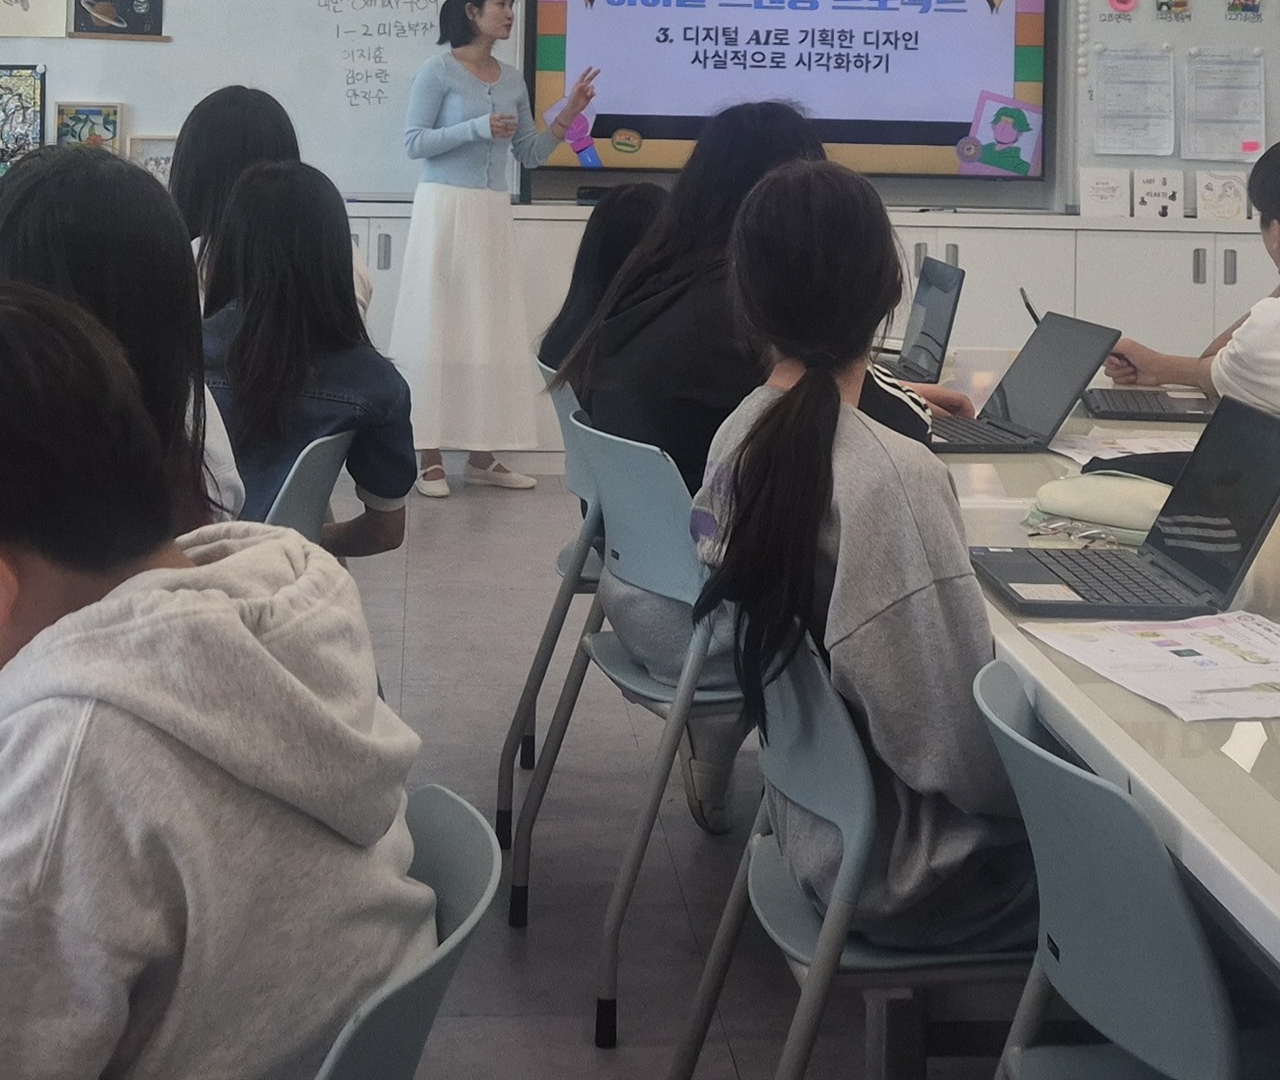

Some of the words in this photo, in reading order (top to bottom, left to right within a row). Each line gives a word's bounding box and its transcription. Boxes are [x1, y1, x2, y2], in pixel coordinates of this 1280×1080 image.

[655, 27, 675, 43] 3.
[683, 25, 739, 46] 디지털
[746, 28, 790, 46] AI로
[798, 28, 856, 50] 기획한
[863, 30, 920, 51] 디자인
[690, 49, 787, 70] 사실적으로
[795, 51, 890, 73] 시각화하기
